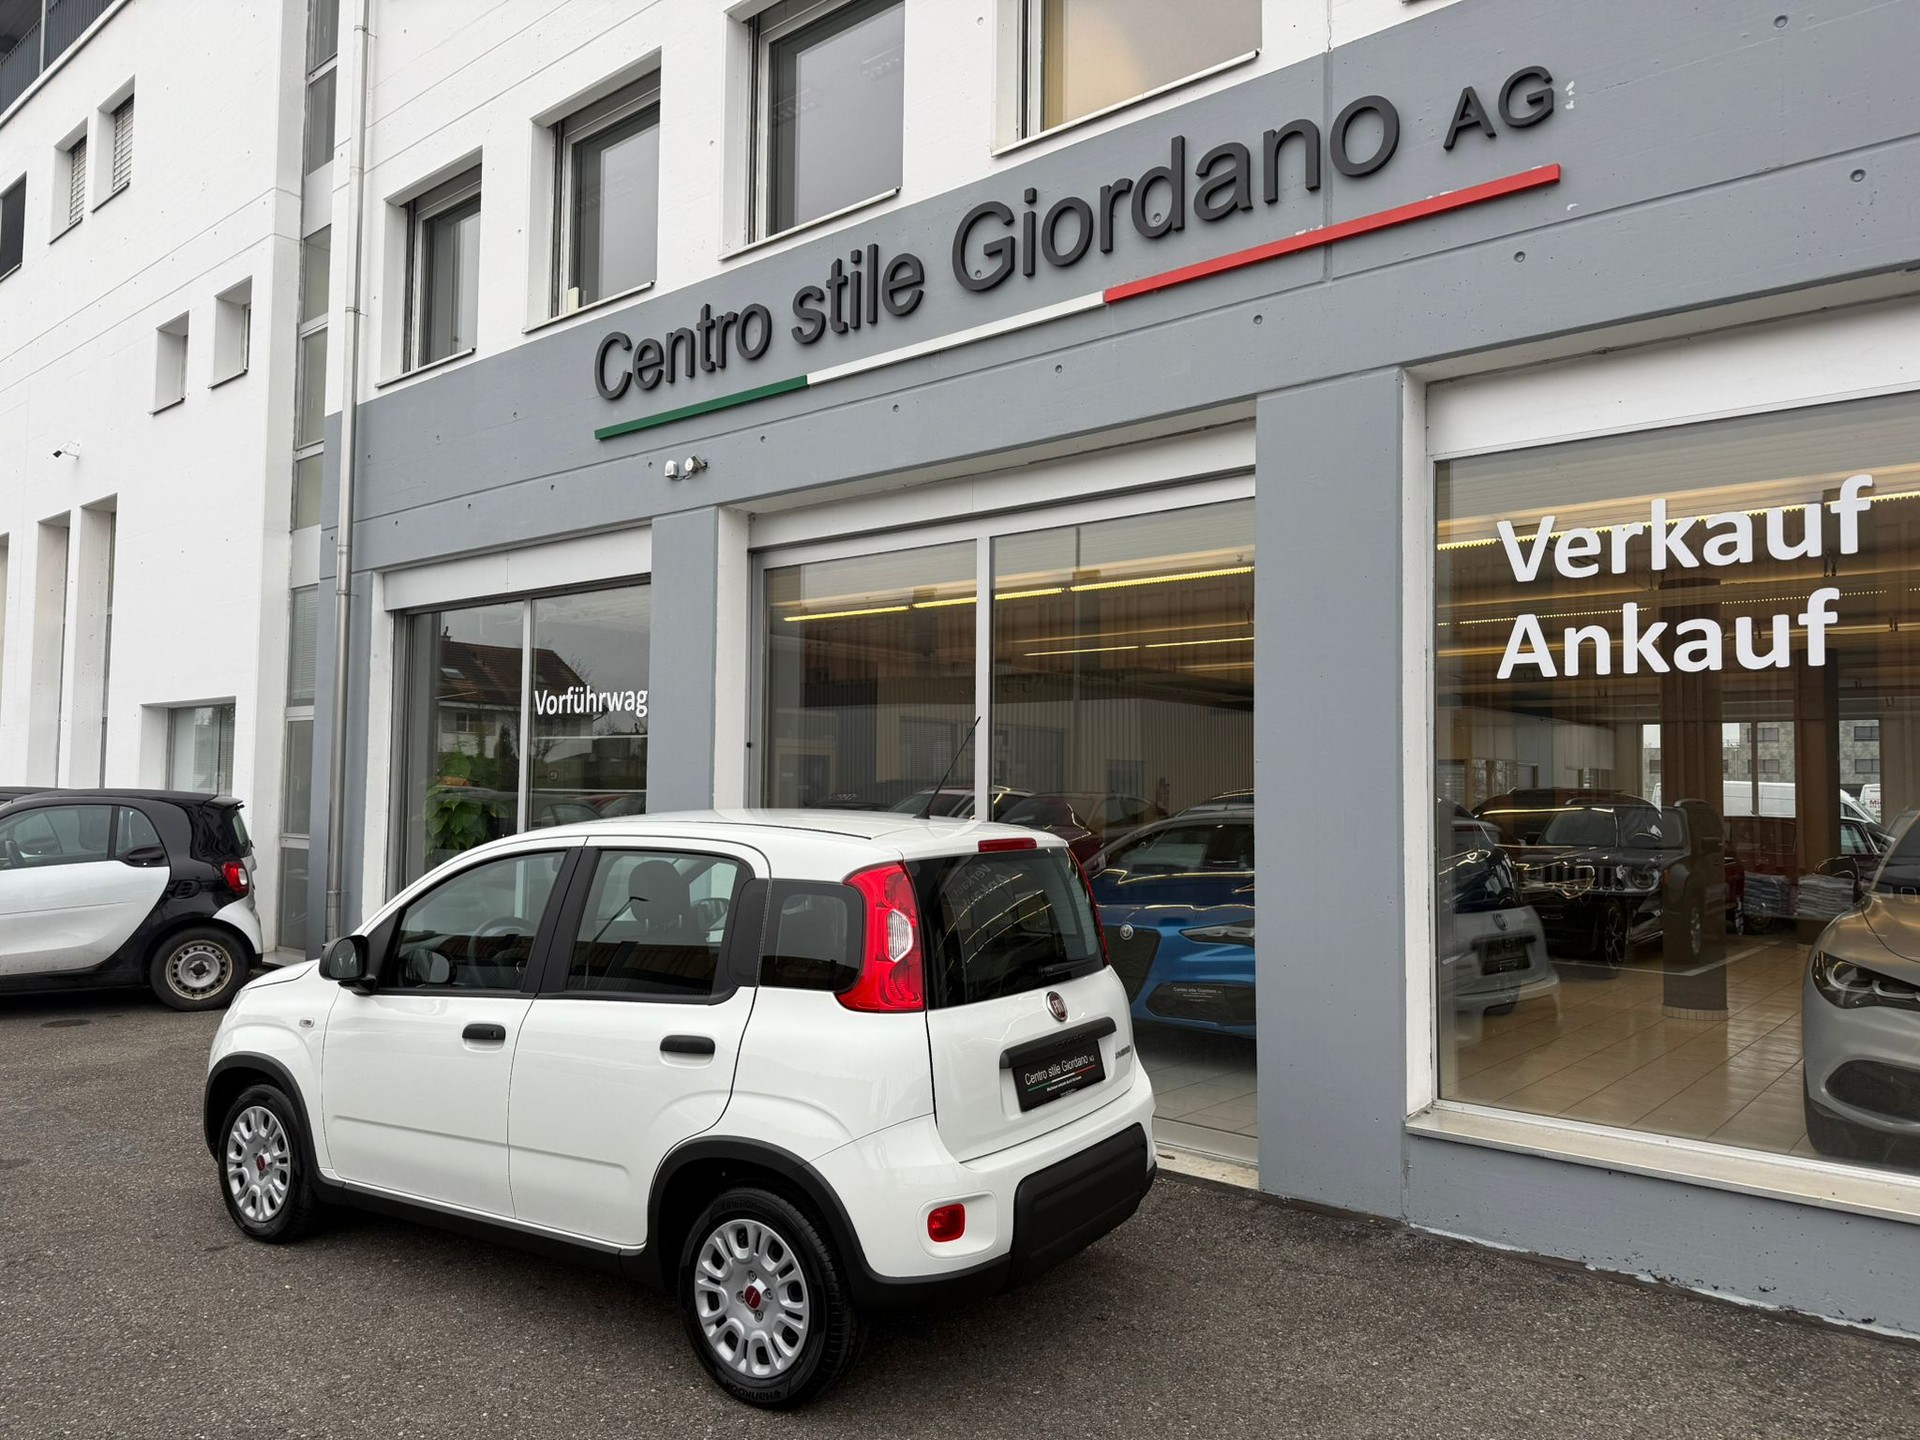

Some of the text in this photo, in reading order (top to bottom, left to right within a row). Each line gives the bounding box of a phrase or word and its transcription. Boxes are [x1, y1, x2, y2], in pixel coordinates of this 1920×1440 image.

[594, 65, 1555, 400] Centro stile Giordano AG
[1497, 474, 1874, 582] Verkauf
[1496, 587, 1841, 679] Ankauf
[534, 685, 648, 718] Vorführwag
[1024, 1070, 1047, 1086] Centro
[1048, 1063, 1061, 1077] stile
[1061, 1055, 1088, 1072] Giordano
